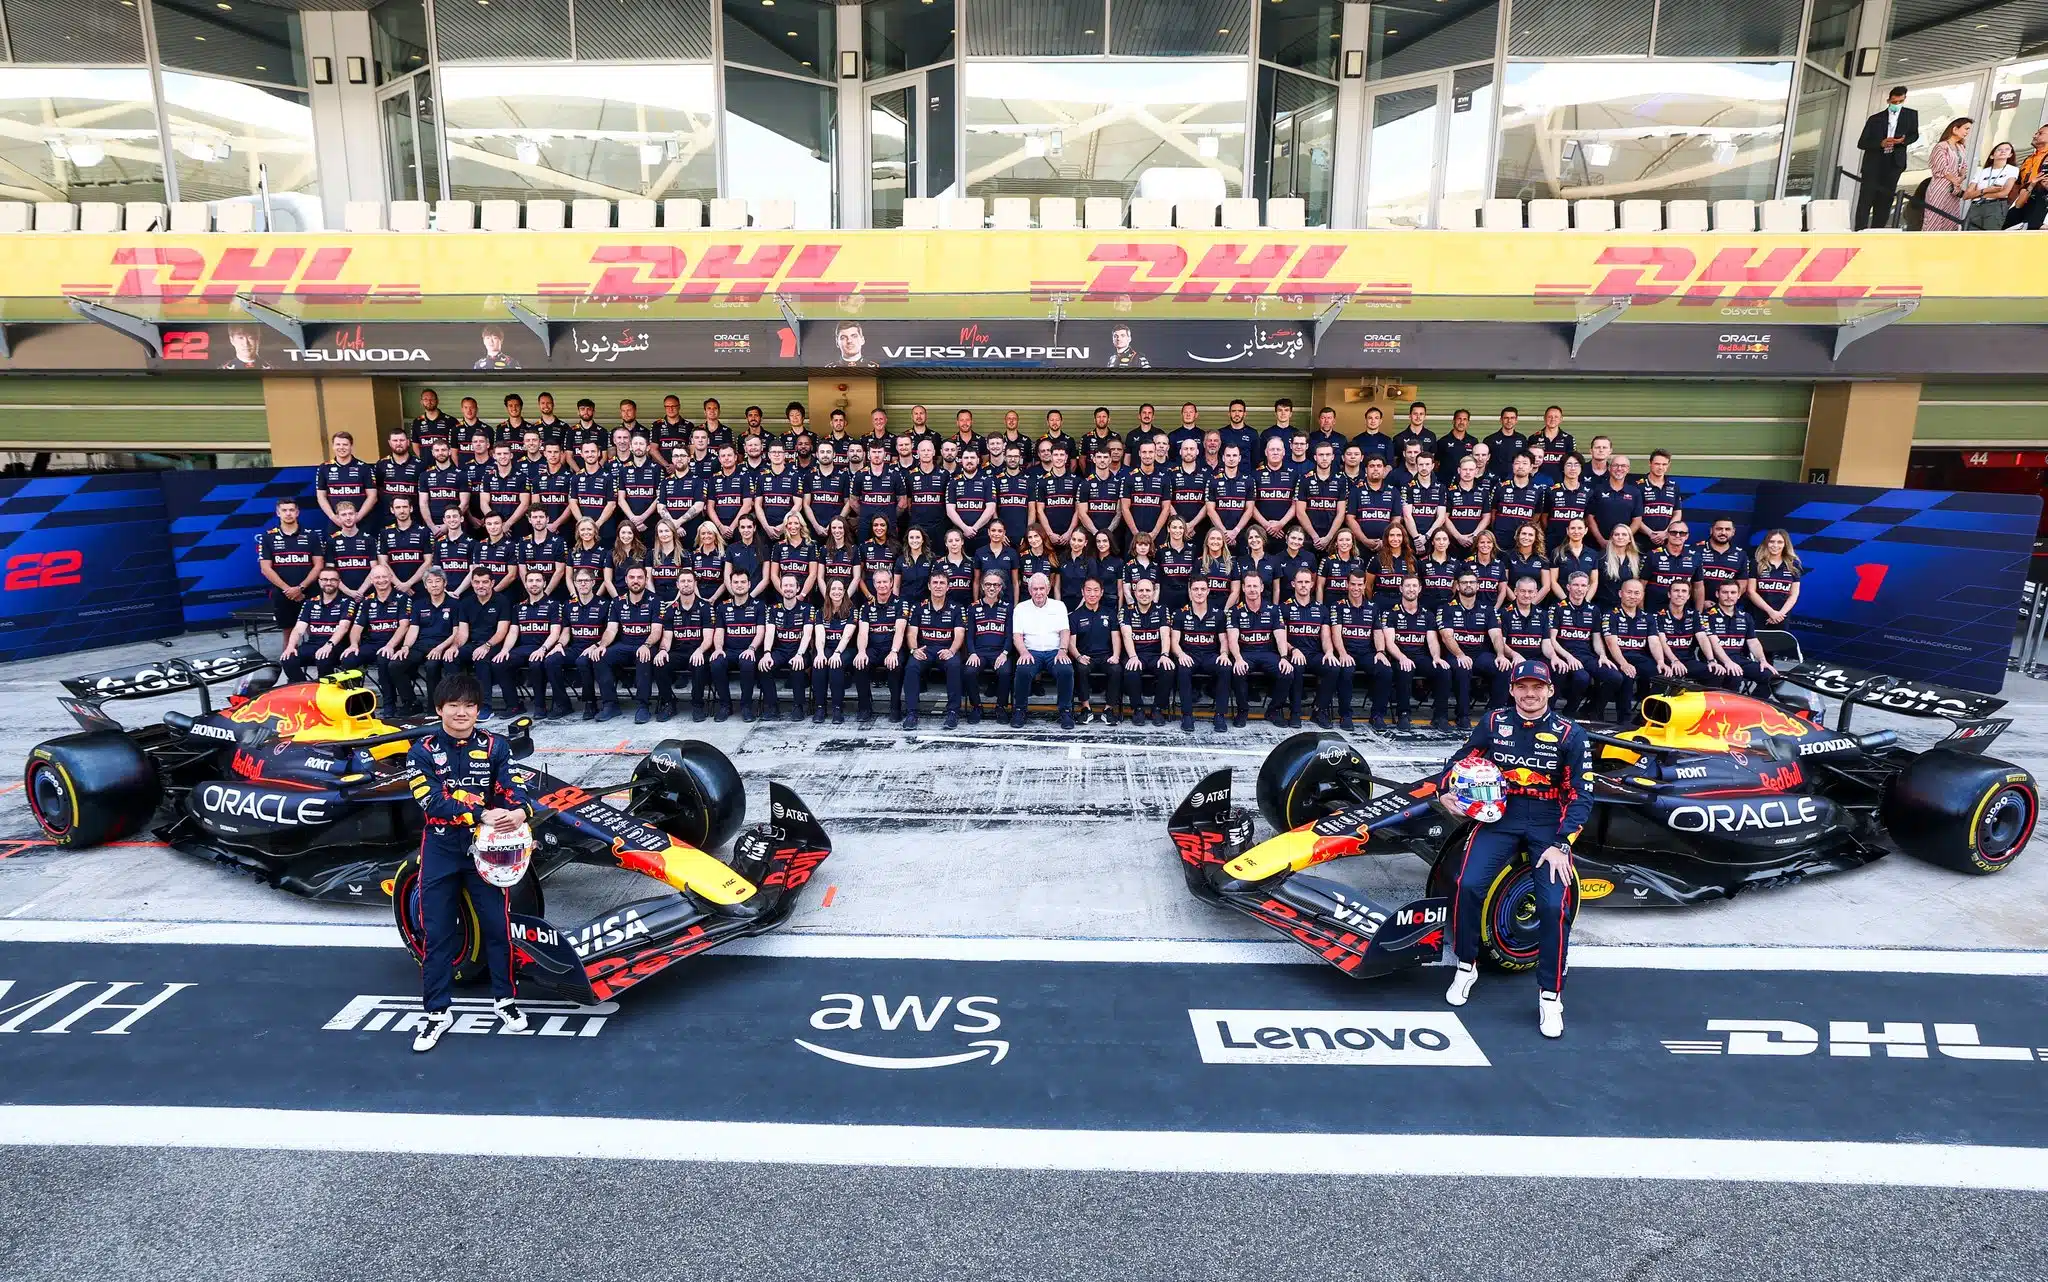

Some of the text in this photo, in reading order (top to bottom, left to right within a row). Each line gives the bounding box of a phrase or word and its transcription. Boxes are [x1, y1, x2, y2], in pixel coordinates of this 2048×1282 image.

[109, 247, 376, 304] DHL
[588, 245, 859, 303] DHL
[1087, 244, 1358, 303] DHL
[1592, 247, 1872, 305] DHL
[335, 325, 365, 350] Yuki
[960, 324, 990, 346] Max
[163, 331, 208, 359] 22
[776, 327, 798, 357] 1
[283, 349, 431, 362] TSUNODA
[881, 346, 1090, 359] VERSTAPPEN
[1970, 452, 1989, 465] 44
[1812, 473, 1825, 484] 14
[329, 486, 360, 494] Red Bull
[386, 484, 414, 493] Red Bull
[626, 488, 653, 496] Red Bull
[826, 494, 838, 502] Bull
[864, 494, 890, 502] Red Bull
[1048, 497, 1073, 505] Red Bull
[1134, 496, 1159, 504] Red Bull
[1219, 500, 1244, 508] Red Bull
[1311, 500, 1322, 508] Red
[957, 501, 983, 509] Red Bull
[1090, 502, 1115, 510] Red Bull
[1502, 506, 1532, 516] Red Bull
[1644, 506, 1658, 514] Red
[1362, 511, 1390, 520] Red Bull
[1452, 508, 1481, 517] Red Bull
[275, 554, 308, 564] Red Bull
[338, 559, 366, 567] Red Bull
[4, 550, 83, 592] 22
[1852, 563, 1889, 602] 1
[674, 630, 700, 638] Red Bull
[977, 624, 1004, 632] Red Bull
[1290, 625, 1320, 634] Red Bull
[1185, 634, 1214, 643] Red Bull
[1410, 634, 1425, 643] Bull
[1454, 632, 1484, 643] Red Bull
[1883, 634, 1972, 652] REDBULLRACING.COM
[190, 724, 236, 742] HONDA
[1948, 725, 1992, 740] Mobil
[1799, 737, 1857, 756] HONDA
[304, 757, 334, 771] ROKT
[1493, 752, 1558, 769] ORACLE
[1676, 766, 1709, 779] ROKT
[1759, 761, 1804, 792] Red Bull
[538, 786, 594, 812] 22
[1206, 788, 1230, 804] AT&T
[203, 785, 332, 825] ORACLE
[786, 809, 809, 823] AT&T
[1668, 797, 1818, 832] ORACLE
[1428, 826, 1442, 836] FIA
[545, 834, 557, 844] FIA
[1580, 883, 1608, 893] AUCH
[1333, 891, 1387, 934] VIS
[1397, 907, 1448, 926] Mobil
[511, 923, 559, 946] Mobil
[567, 909, 650, 957] VISA
[809, 993, 1001, 1035] aws
[1216, 1020, 1452, 1052] Lenovo
[1706, 1019, 2034, 1061] DHL
